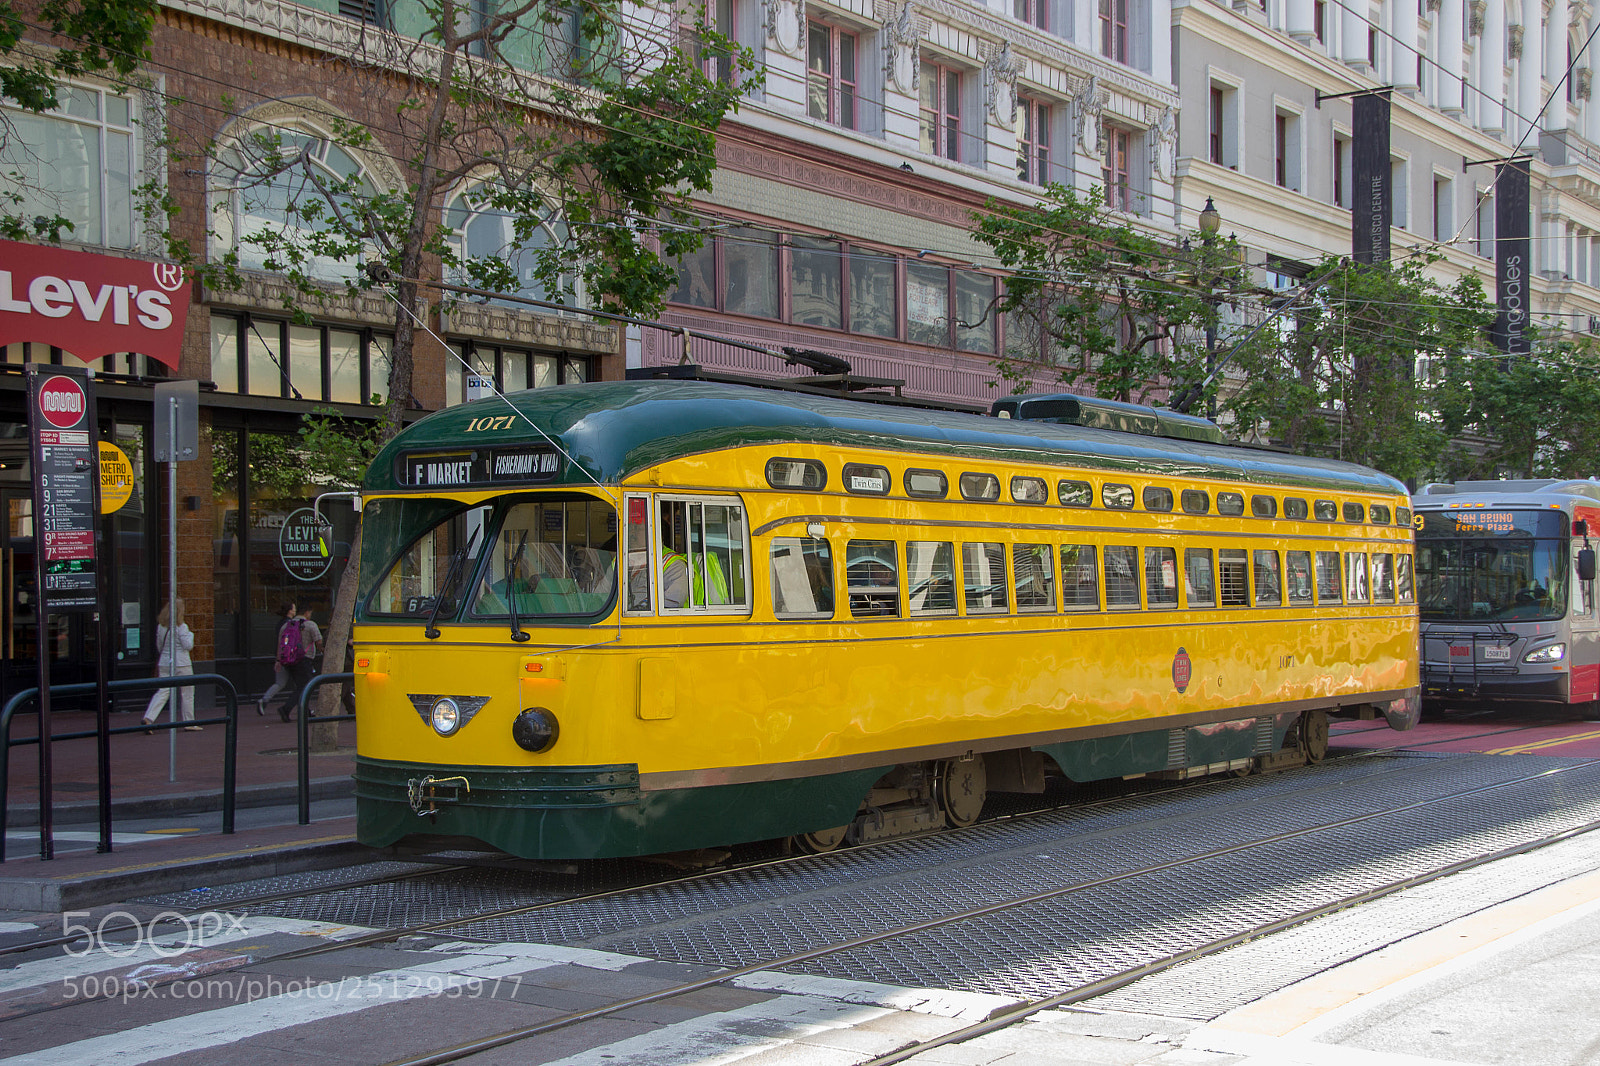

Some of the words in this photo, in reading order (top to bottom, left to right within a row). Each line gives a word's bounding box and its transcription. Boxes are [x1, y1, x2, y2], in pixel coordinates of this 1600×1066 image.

[1372, 175, 1382, 212] CENTRE
[1372, 214, 1382, 264] RANCISCO
[464, 415, 516, 432] 1071
[42, 447, 51, 461] F
[101, 463, 126, 473] METRO
[495, 454, 539, 475] FISHERMAN'S
[416, 464, 423, 485] F
[427, 461, 472, 485] MARKET
[42, 474, 49, 487] 6
[101, 475, 132, 485] SHUTTLE
[853, 477, 867, 488] Twin
[44, 490, 51, 502] 9
[43, 504, 55, 516] 21
[44, 518, 56, 530] 31
[301, 516, 314, 524] THE
[1414, 514, 1424, 530] 9
[1457, 514, 1476, 523] SAN
[1480, 513, 1513, 523] BRUNO
[1456, 524, 1483, 532] Ferry
[1487, 523, 1514, 531] Plaza
[285, 544, 309, 552] TAILOR
[311, 544, 321, 552] SH
[1279, 655, 1295, 668] 1071
